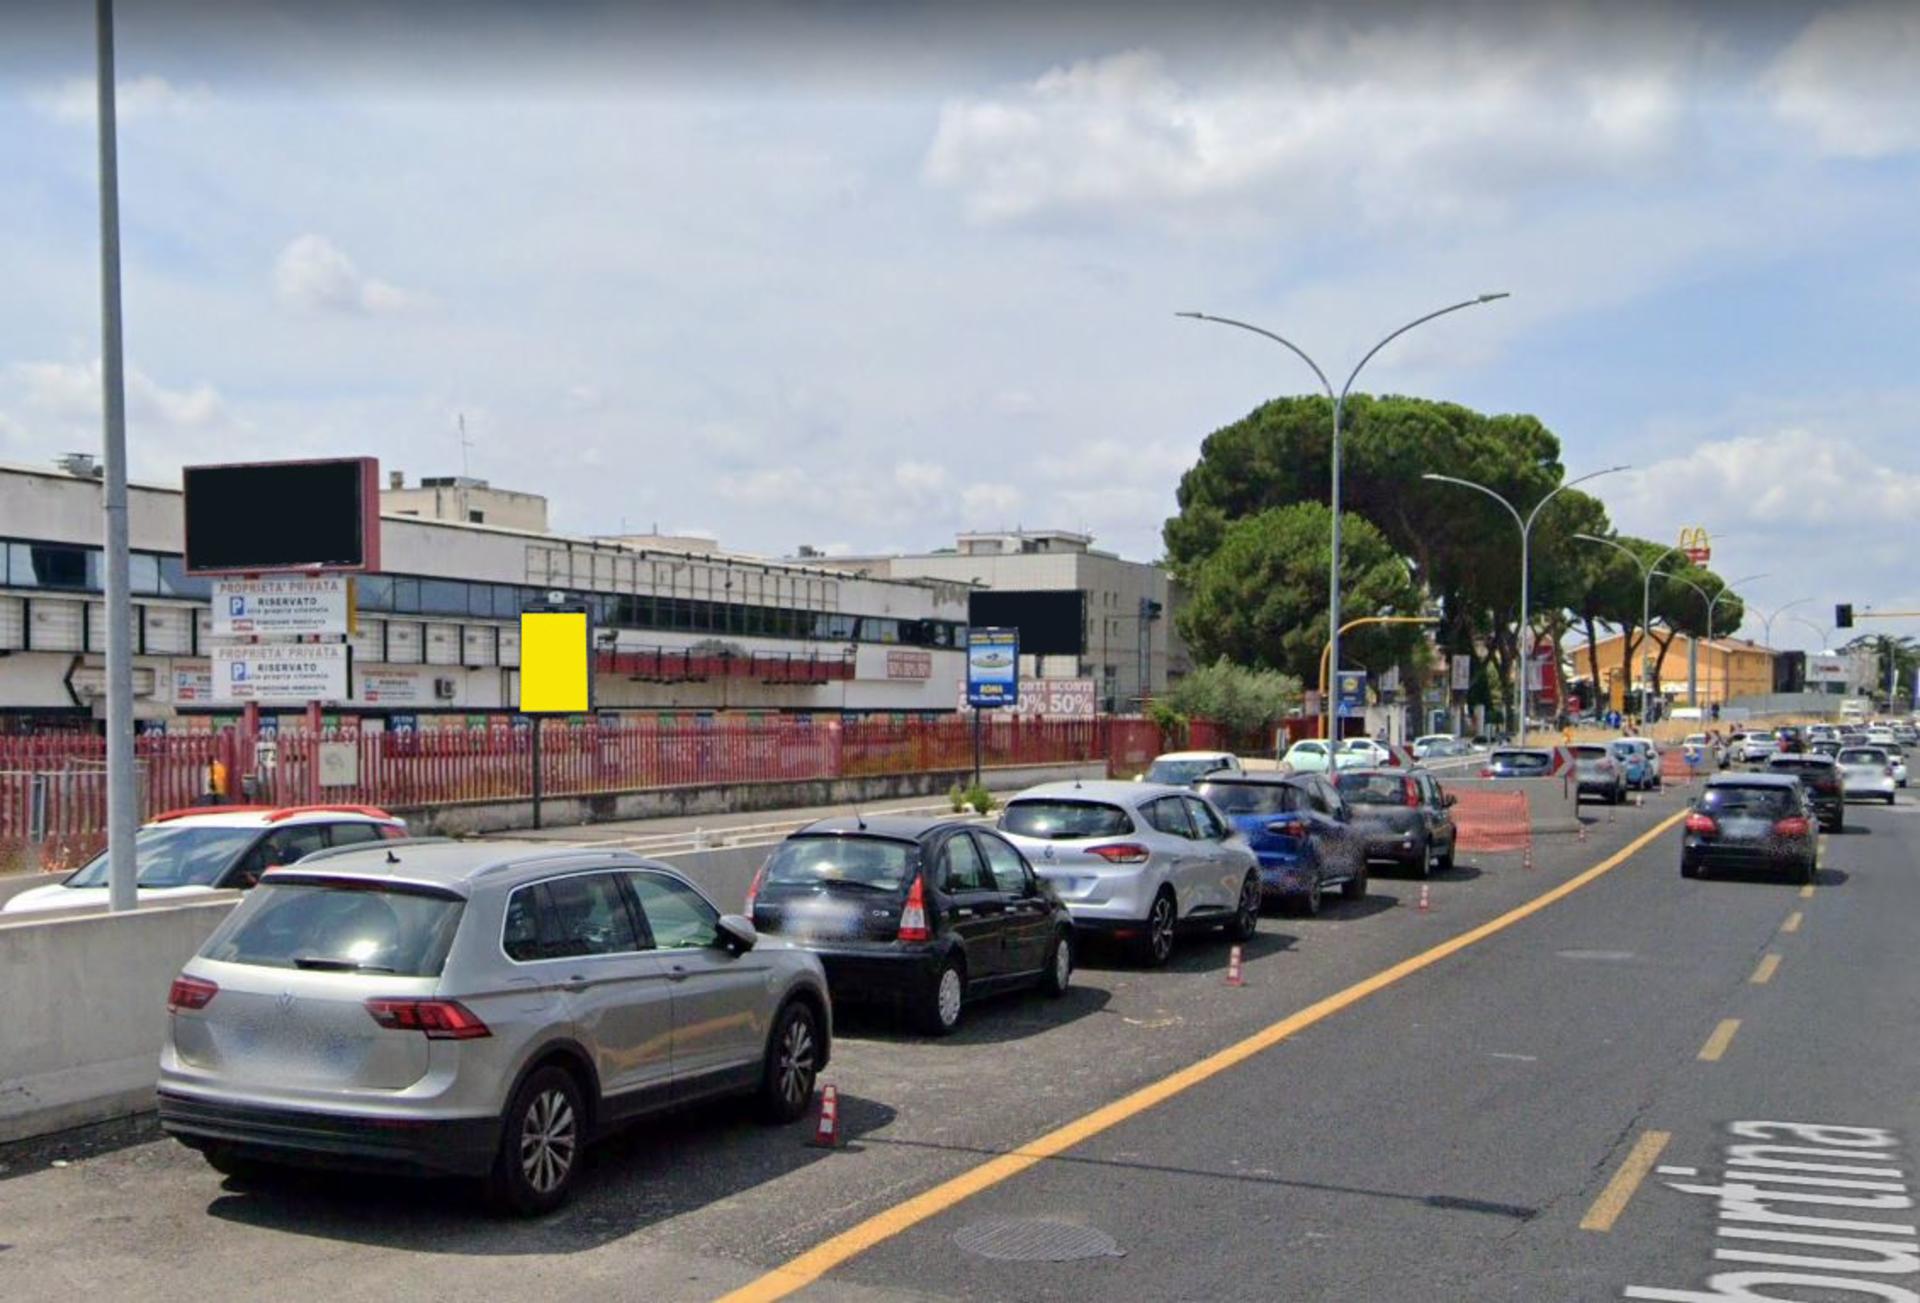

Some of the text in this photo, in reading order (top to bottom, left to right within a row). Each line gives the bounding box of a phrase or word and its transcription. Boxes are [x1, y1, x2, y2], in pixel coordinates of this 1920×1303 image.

[289, 580, 339, 592] PRIVATA
[258, 597, 318, 606] RISERVATO
[257, 663, 318, 672] RISERVATO
[1050, 693, 1093, 712] 50%
